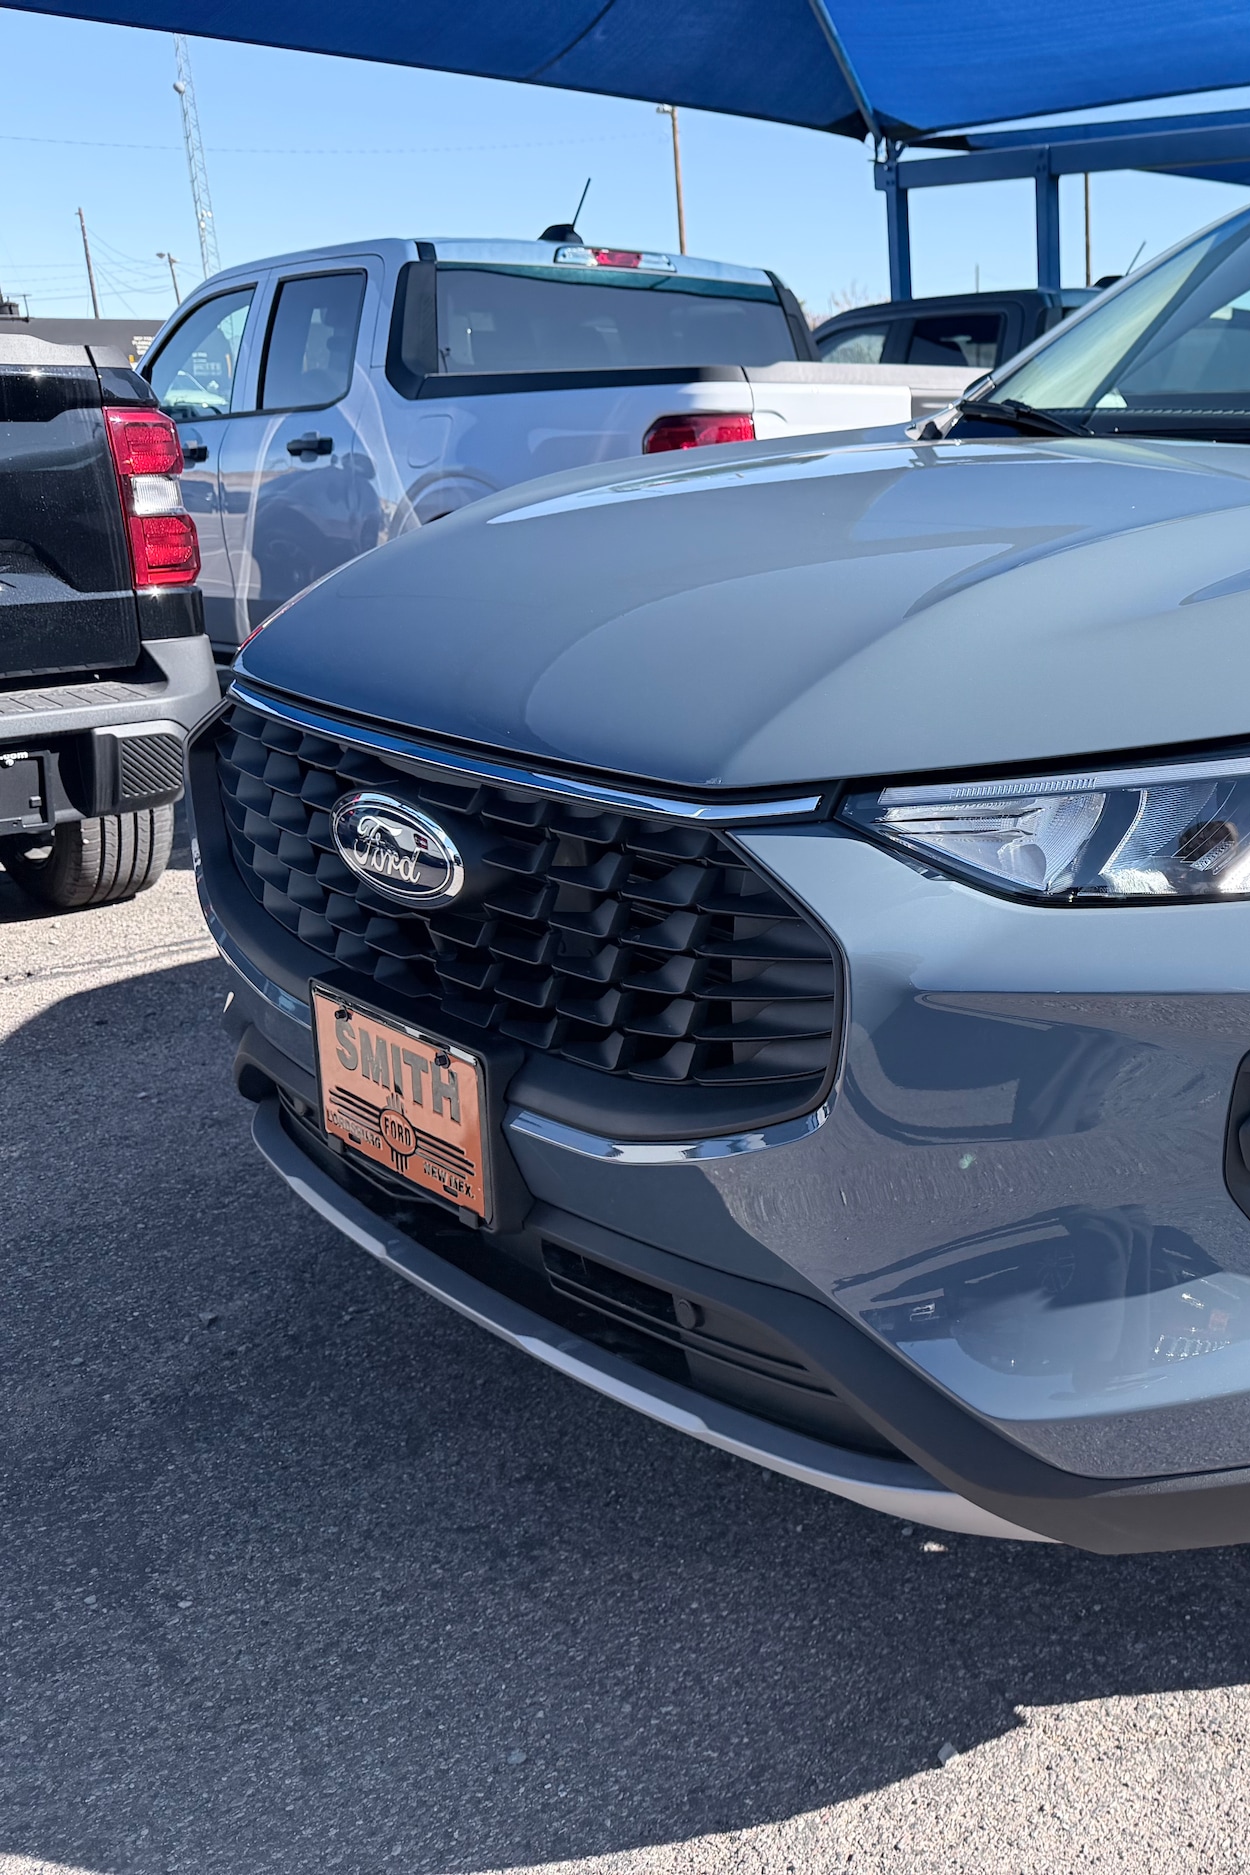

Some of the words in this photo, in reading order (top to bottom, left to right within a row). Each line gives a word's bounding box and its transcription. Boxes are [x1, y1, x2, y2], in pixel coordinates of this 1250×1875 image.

[353, 815, 423, 884] Ford
[335, 1017, 461, 1126] SMITH
[384, 1115, 412, 1147] FORD
[423, 1161, 448, 1183] NEW
